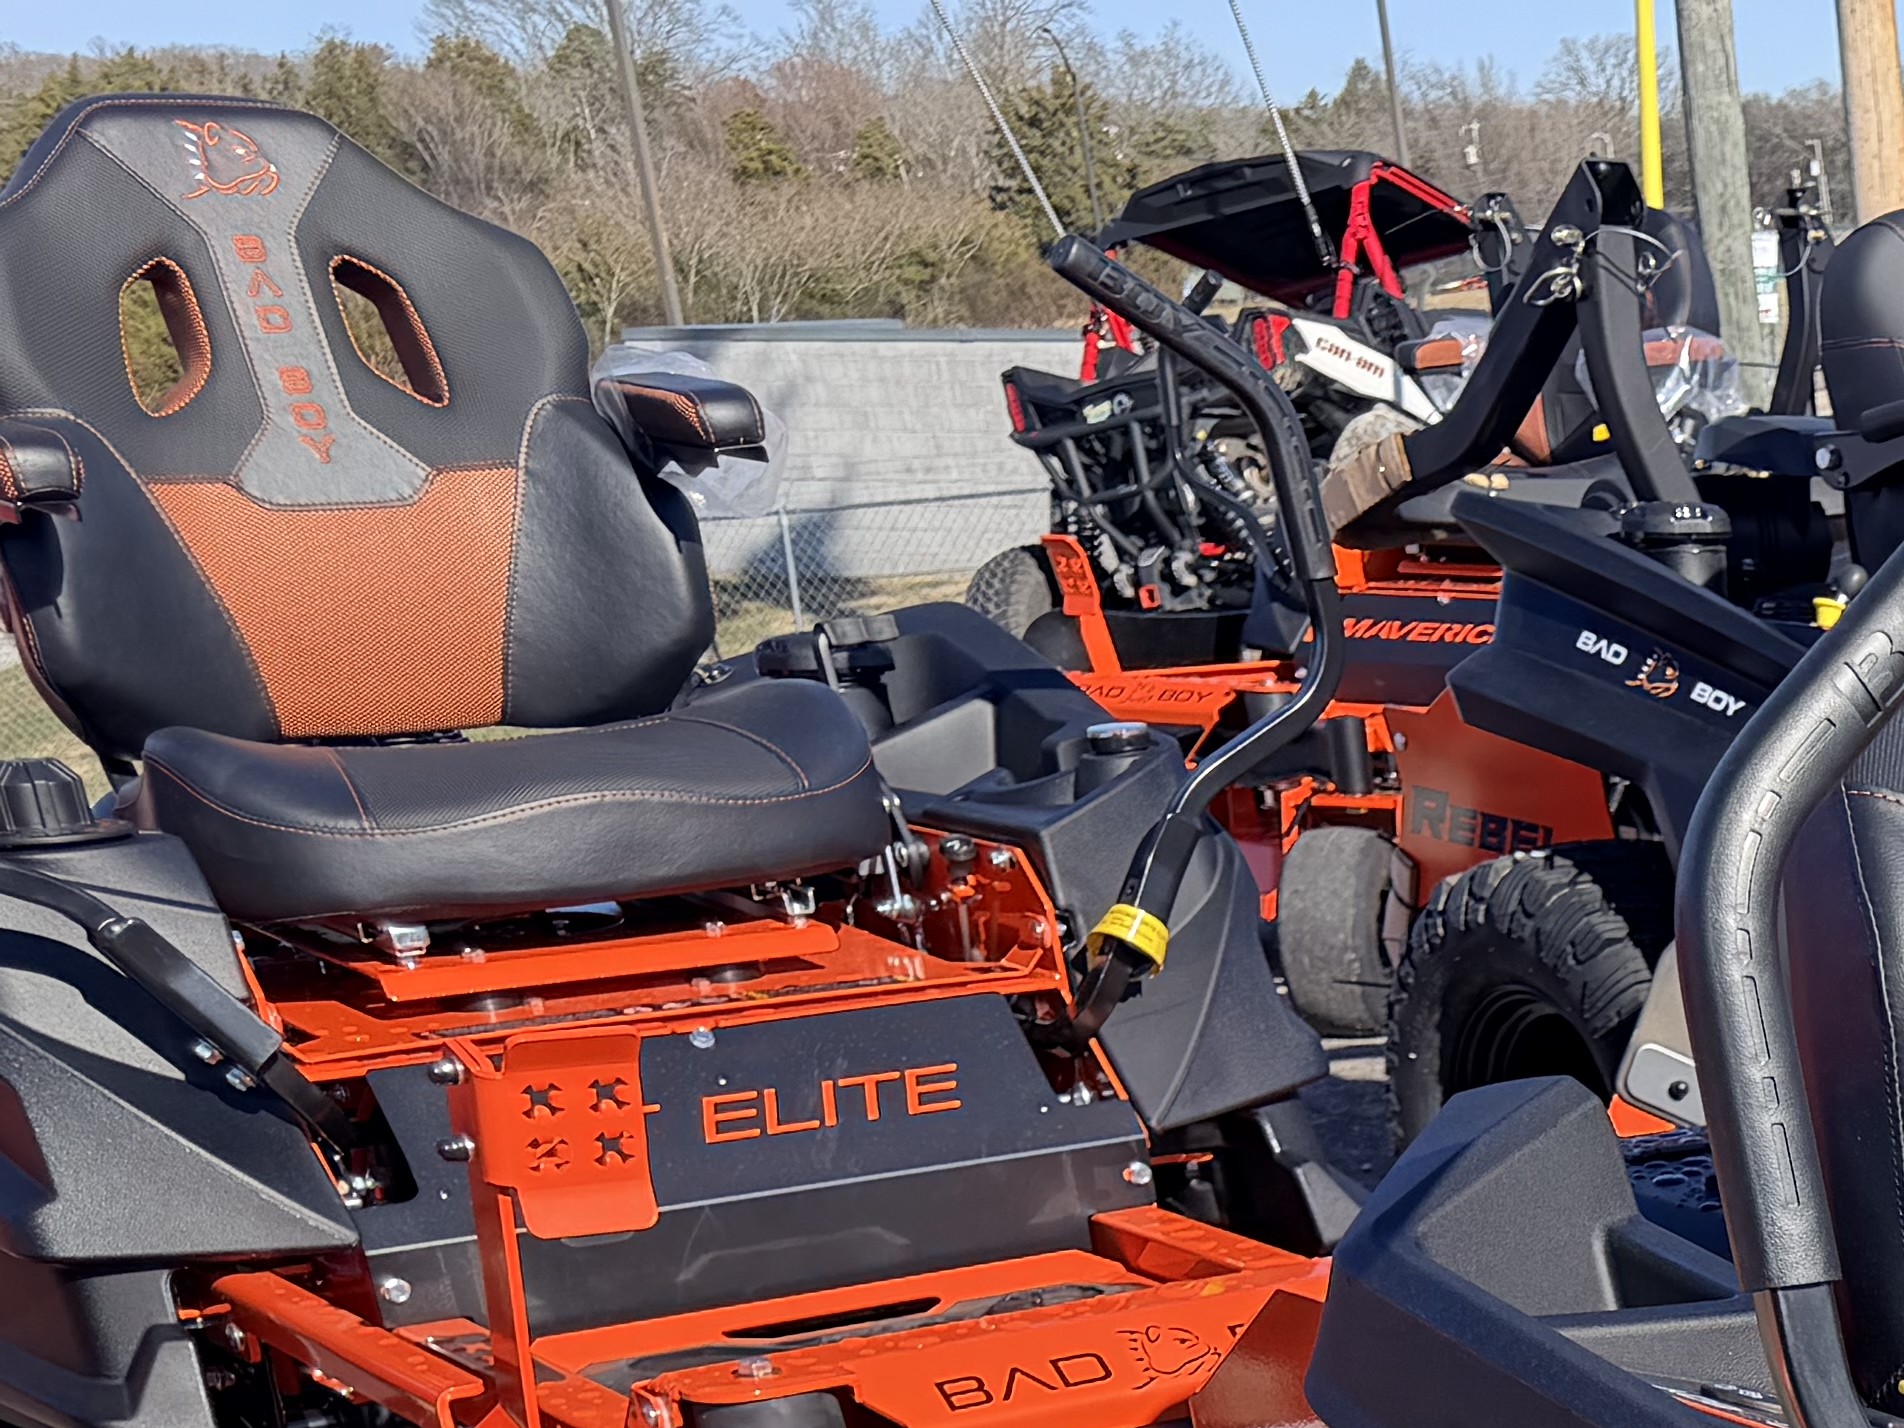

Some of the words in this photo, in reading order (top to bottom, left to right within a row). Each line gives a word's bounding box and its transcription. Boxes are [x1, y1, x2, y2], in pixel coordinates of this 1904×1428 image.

[232, 233, 293, 336] BAD
[278, 365, 335, 465] BOY
[1315, 336, 1386, 379] can-am
[1344, 617, 1497, 644] MAVERIC
[1158, 689, 1213, 703] BOY
[1575, 630, 1628, 666] BAD
[1690, 681, 1746, 717] BOY
[700, 1061, 963, 1146] ELITE
[933, 1351, 1114, 1416] BAD
